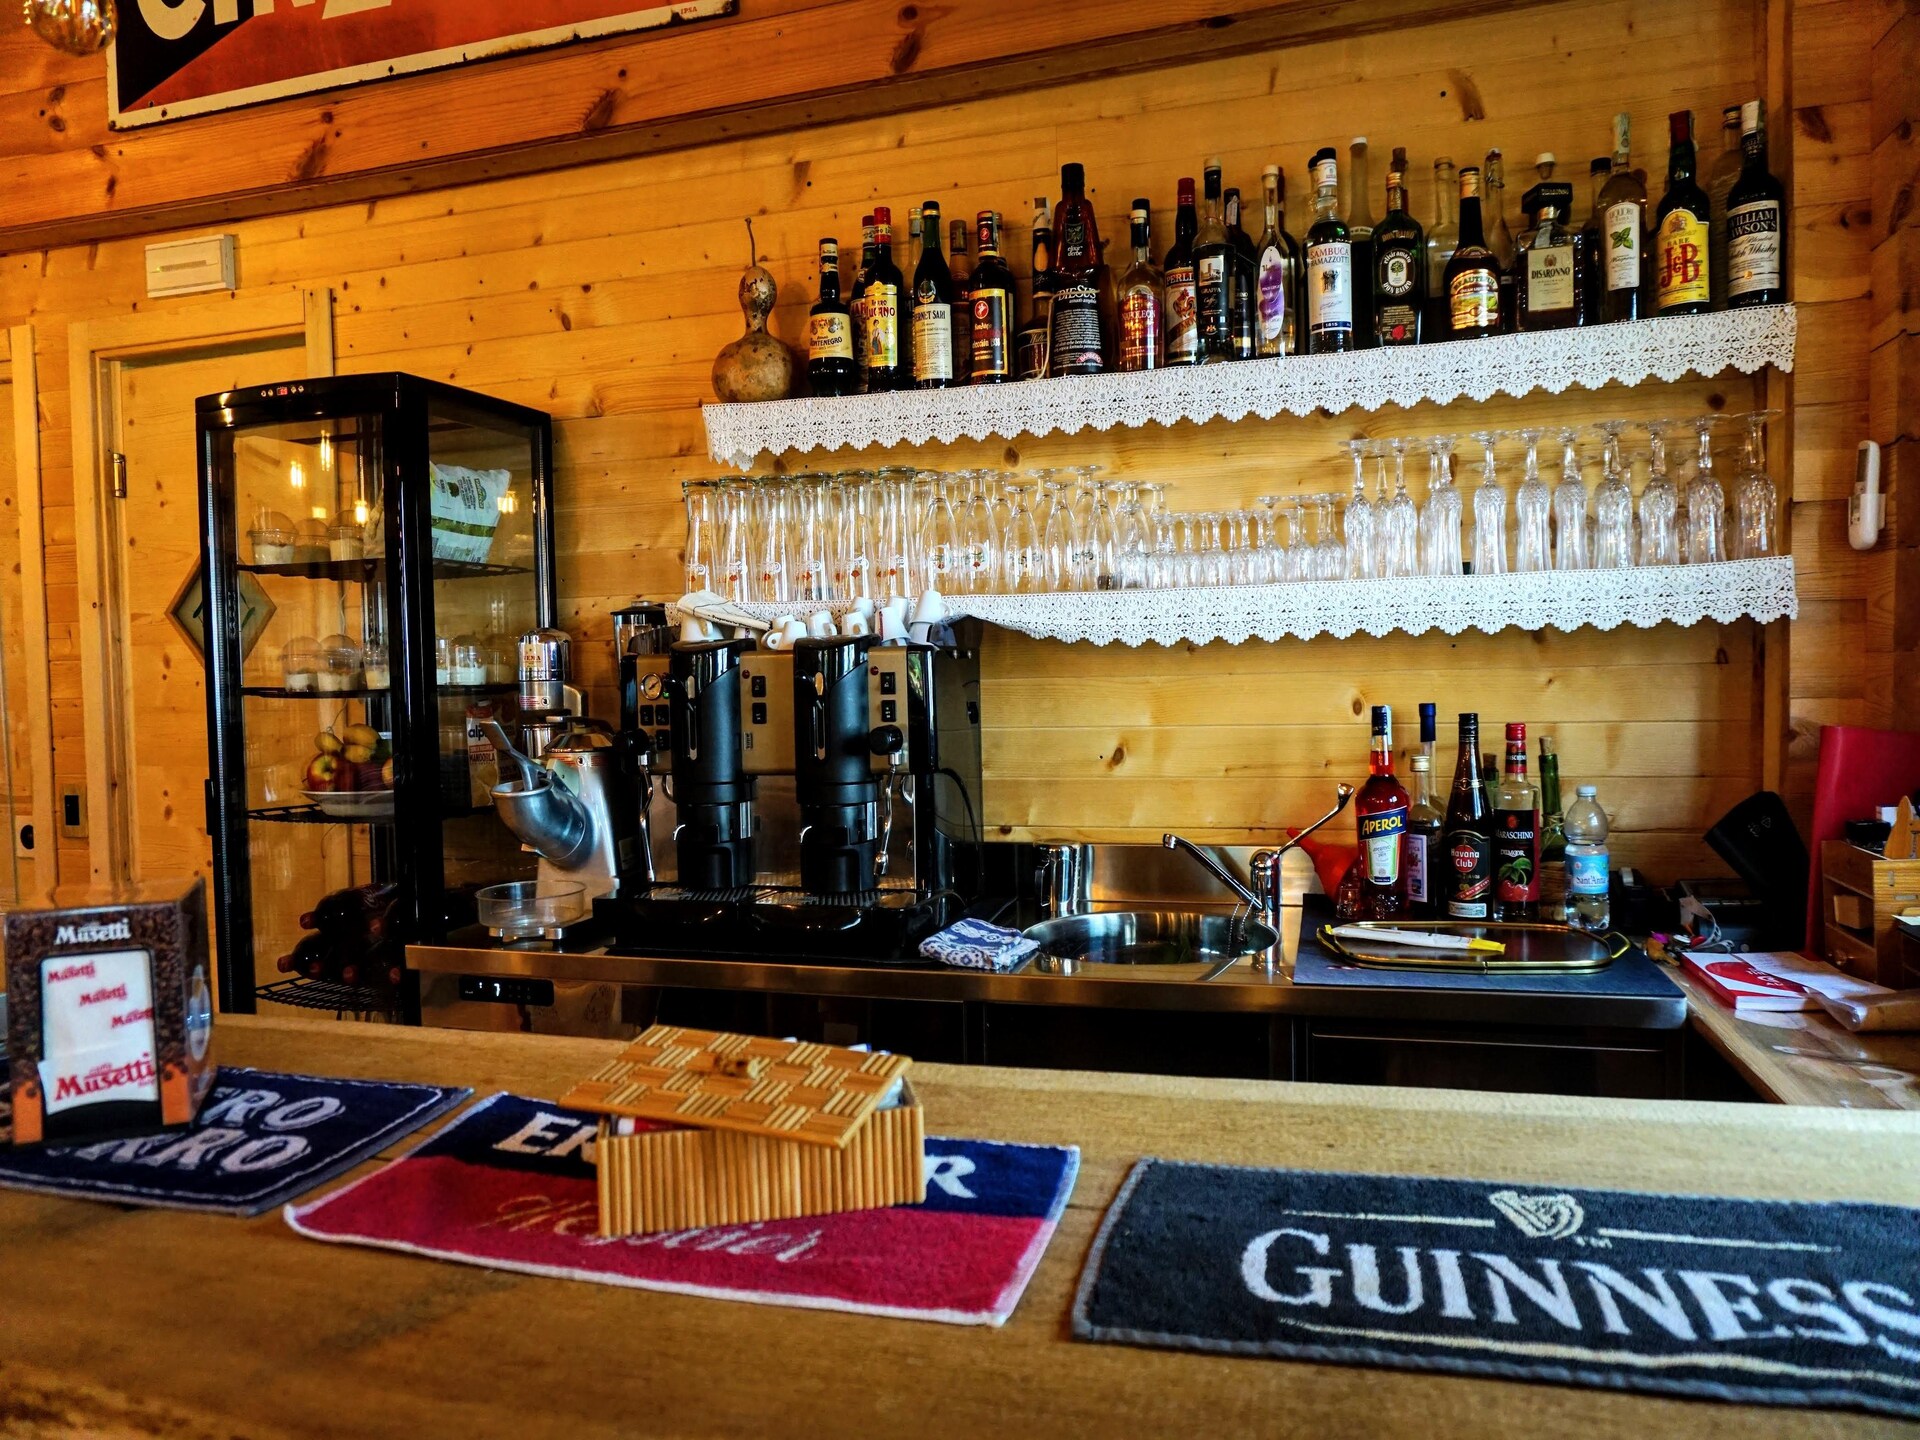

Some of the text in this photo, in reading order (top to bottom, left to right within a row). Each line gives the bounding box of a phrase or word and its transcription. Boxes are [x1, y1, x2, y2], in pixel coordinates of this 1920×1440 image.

[1729, 220, 1777, 240] AWSON'S
[1310, 247, 1349, 260] SAMBUCA
[1748, 243, 1777, 256] Whisky
[1531, 267, 1571, 280] DISARONNO
[1660, 243, 1700, 288] J&B
[866, 305, 896, 320] LUCANO
[468, 725, 486, 742] alp
[1362, 815, 1403, 836] APEROL
[1451, 848, 1480, 859] Havana
[1455, 858, 1473, 868] Club
[54, 917, 131, 946] Musetti
[55, 1052, 156, 1101] Musetti
[1240, 1227, 1920, 1363] GUINNESS
